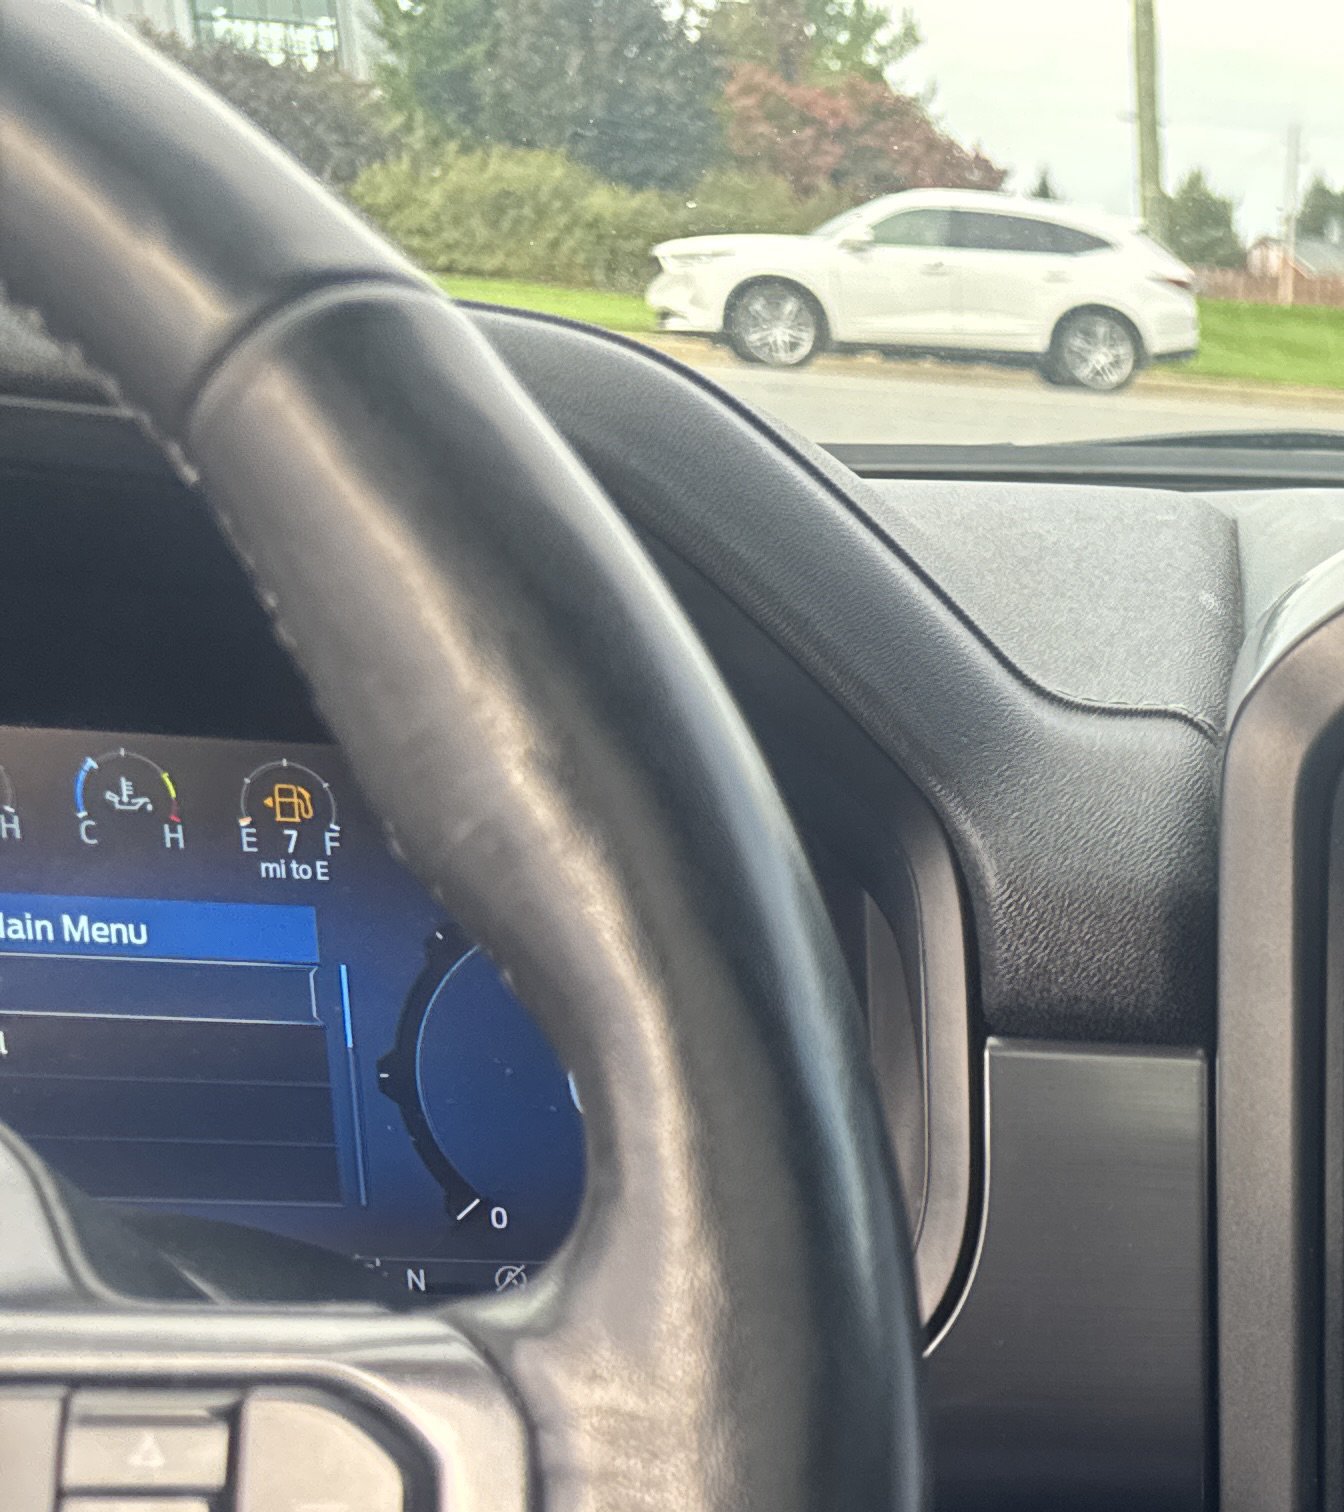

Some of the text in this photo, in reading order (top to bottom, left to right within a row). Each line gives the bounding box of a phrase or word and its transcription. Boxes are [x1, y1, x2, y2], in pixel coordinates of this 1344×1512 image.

[79, 820, 98, 845] C
[163, 824, 185, 849] H
[241, 828, 258, 852] E
[283, 829, 298, 853] 7
[323, 831, 341, 856] F
[260, 859, 330, 880] mi to E
[61, 914, 148, 945] Menu
[490, 1206, 508, 1229] 0
[406, 1268, 426, 1291] N
